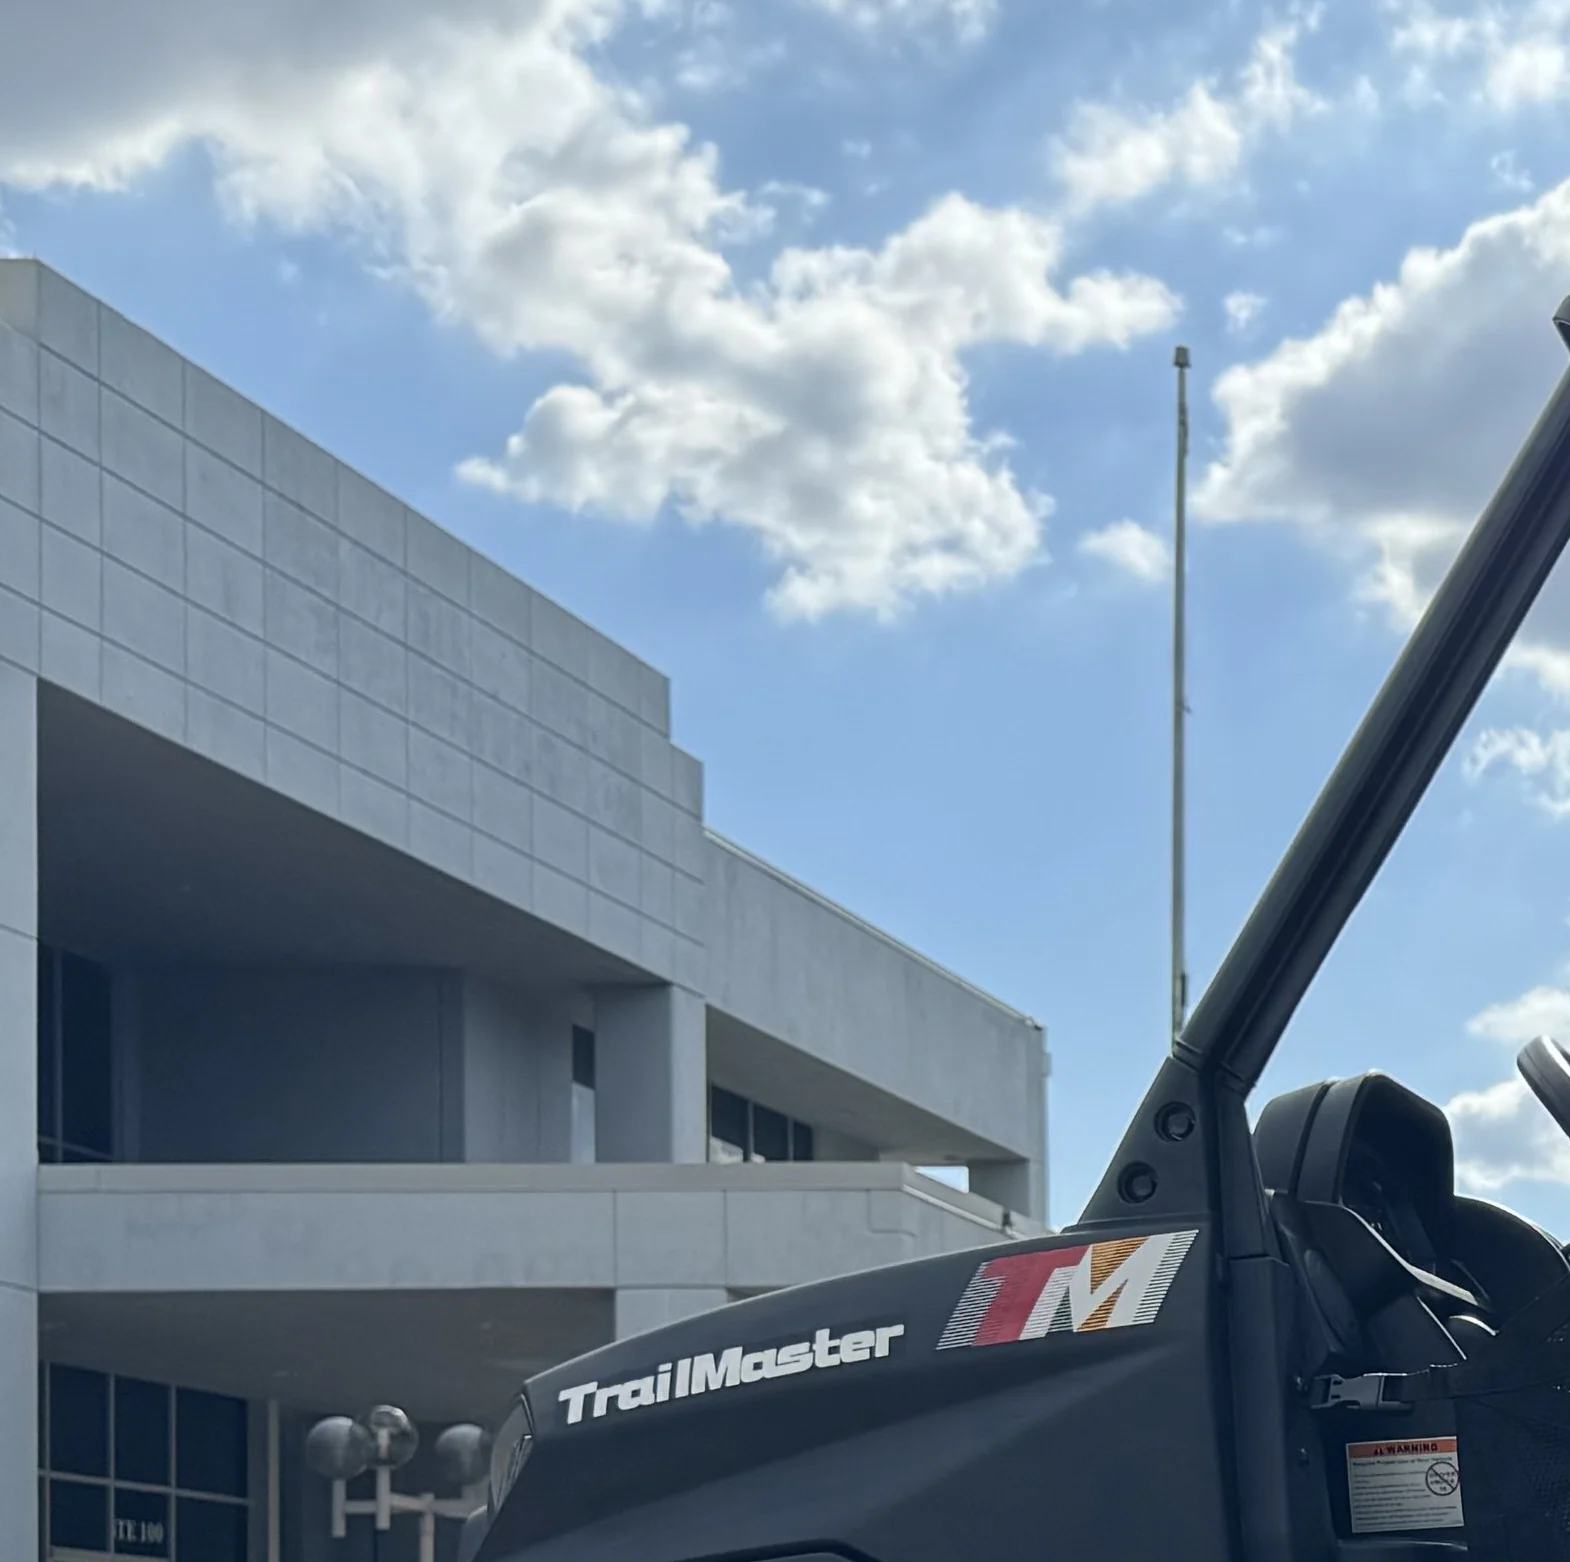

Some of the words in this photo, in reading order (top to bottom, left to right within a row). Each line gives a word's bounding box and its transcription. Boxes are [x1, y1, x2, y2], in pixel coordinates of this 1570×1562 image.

[943, 1229, 1197, 1349] TM
[558, 1324, 905, 1424] TrailMaster
[1386, 1443, 1438, 1455] WARNING
